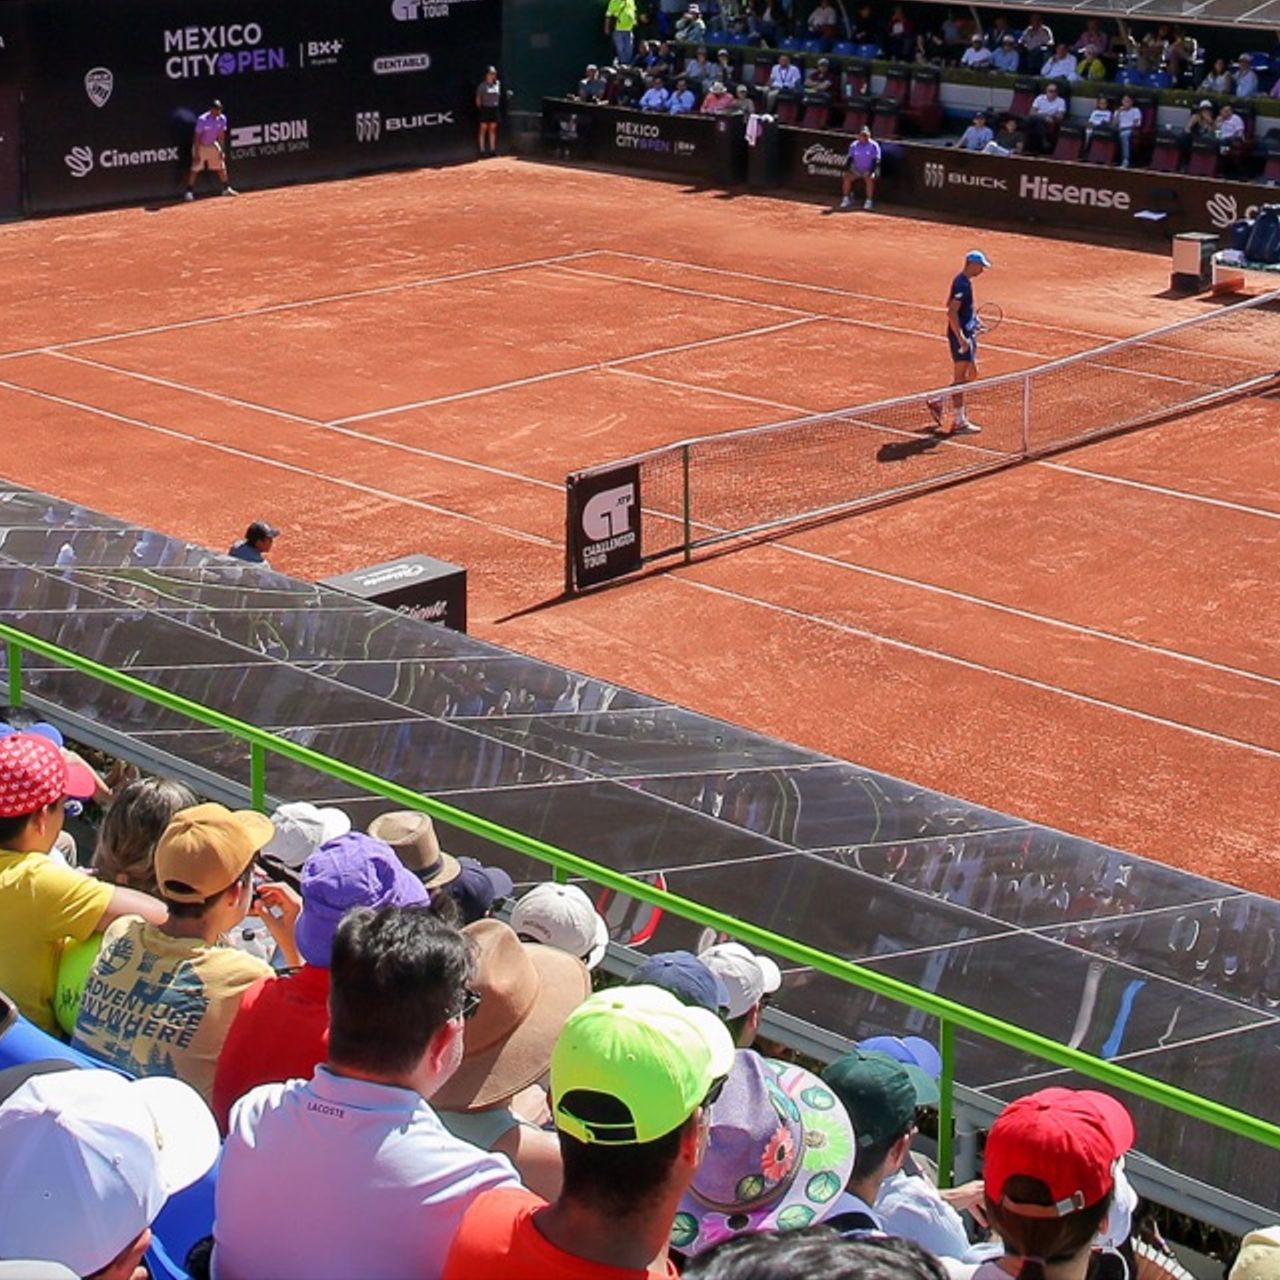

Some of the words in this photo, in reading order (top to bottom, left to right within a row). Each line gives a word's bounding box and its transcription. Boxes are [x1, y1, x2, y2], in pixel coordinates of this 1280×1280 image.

[423, 4, 450, 19] TOUR
[163, 22, 262, 53] MEXICO
[375, 56, 428, 71] RENTABLE
[263, 118, 308, 144] ISDIN
[385, 110, 455, 131] BUICK
[615, 121, 660, 138] MEXICO
[99, 146, 179, 168] Cinemex
[947, 172, 1008, 191] BUICK
[1020, 173, 1131, 210] Hisense
[582, 531, 636, 558] CHALLENGER
[583, 553, 608, 570] TOUR
